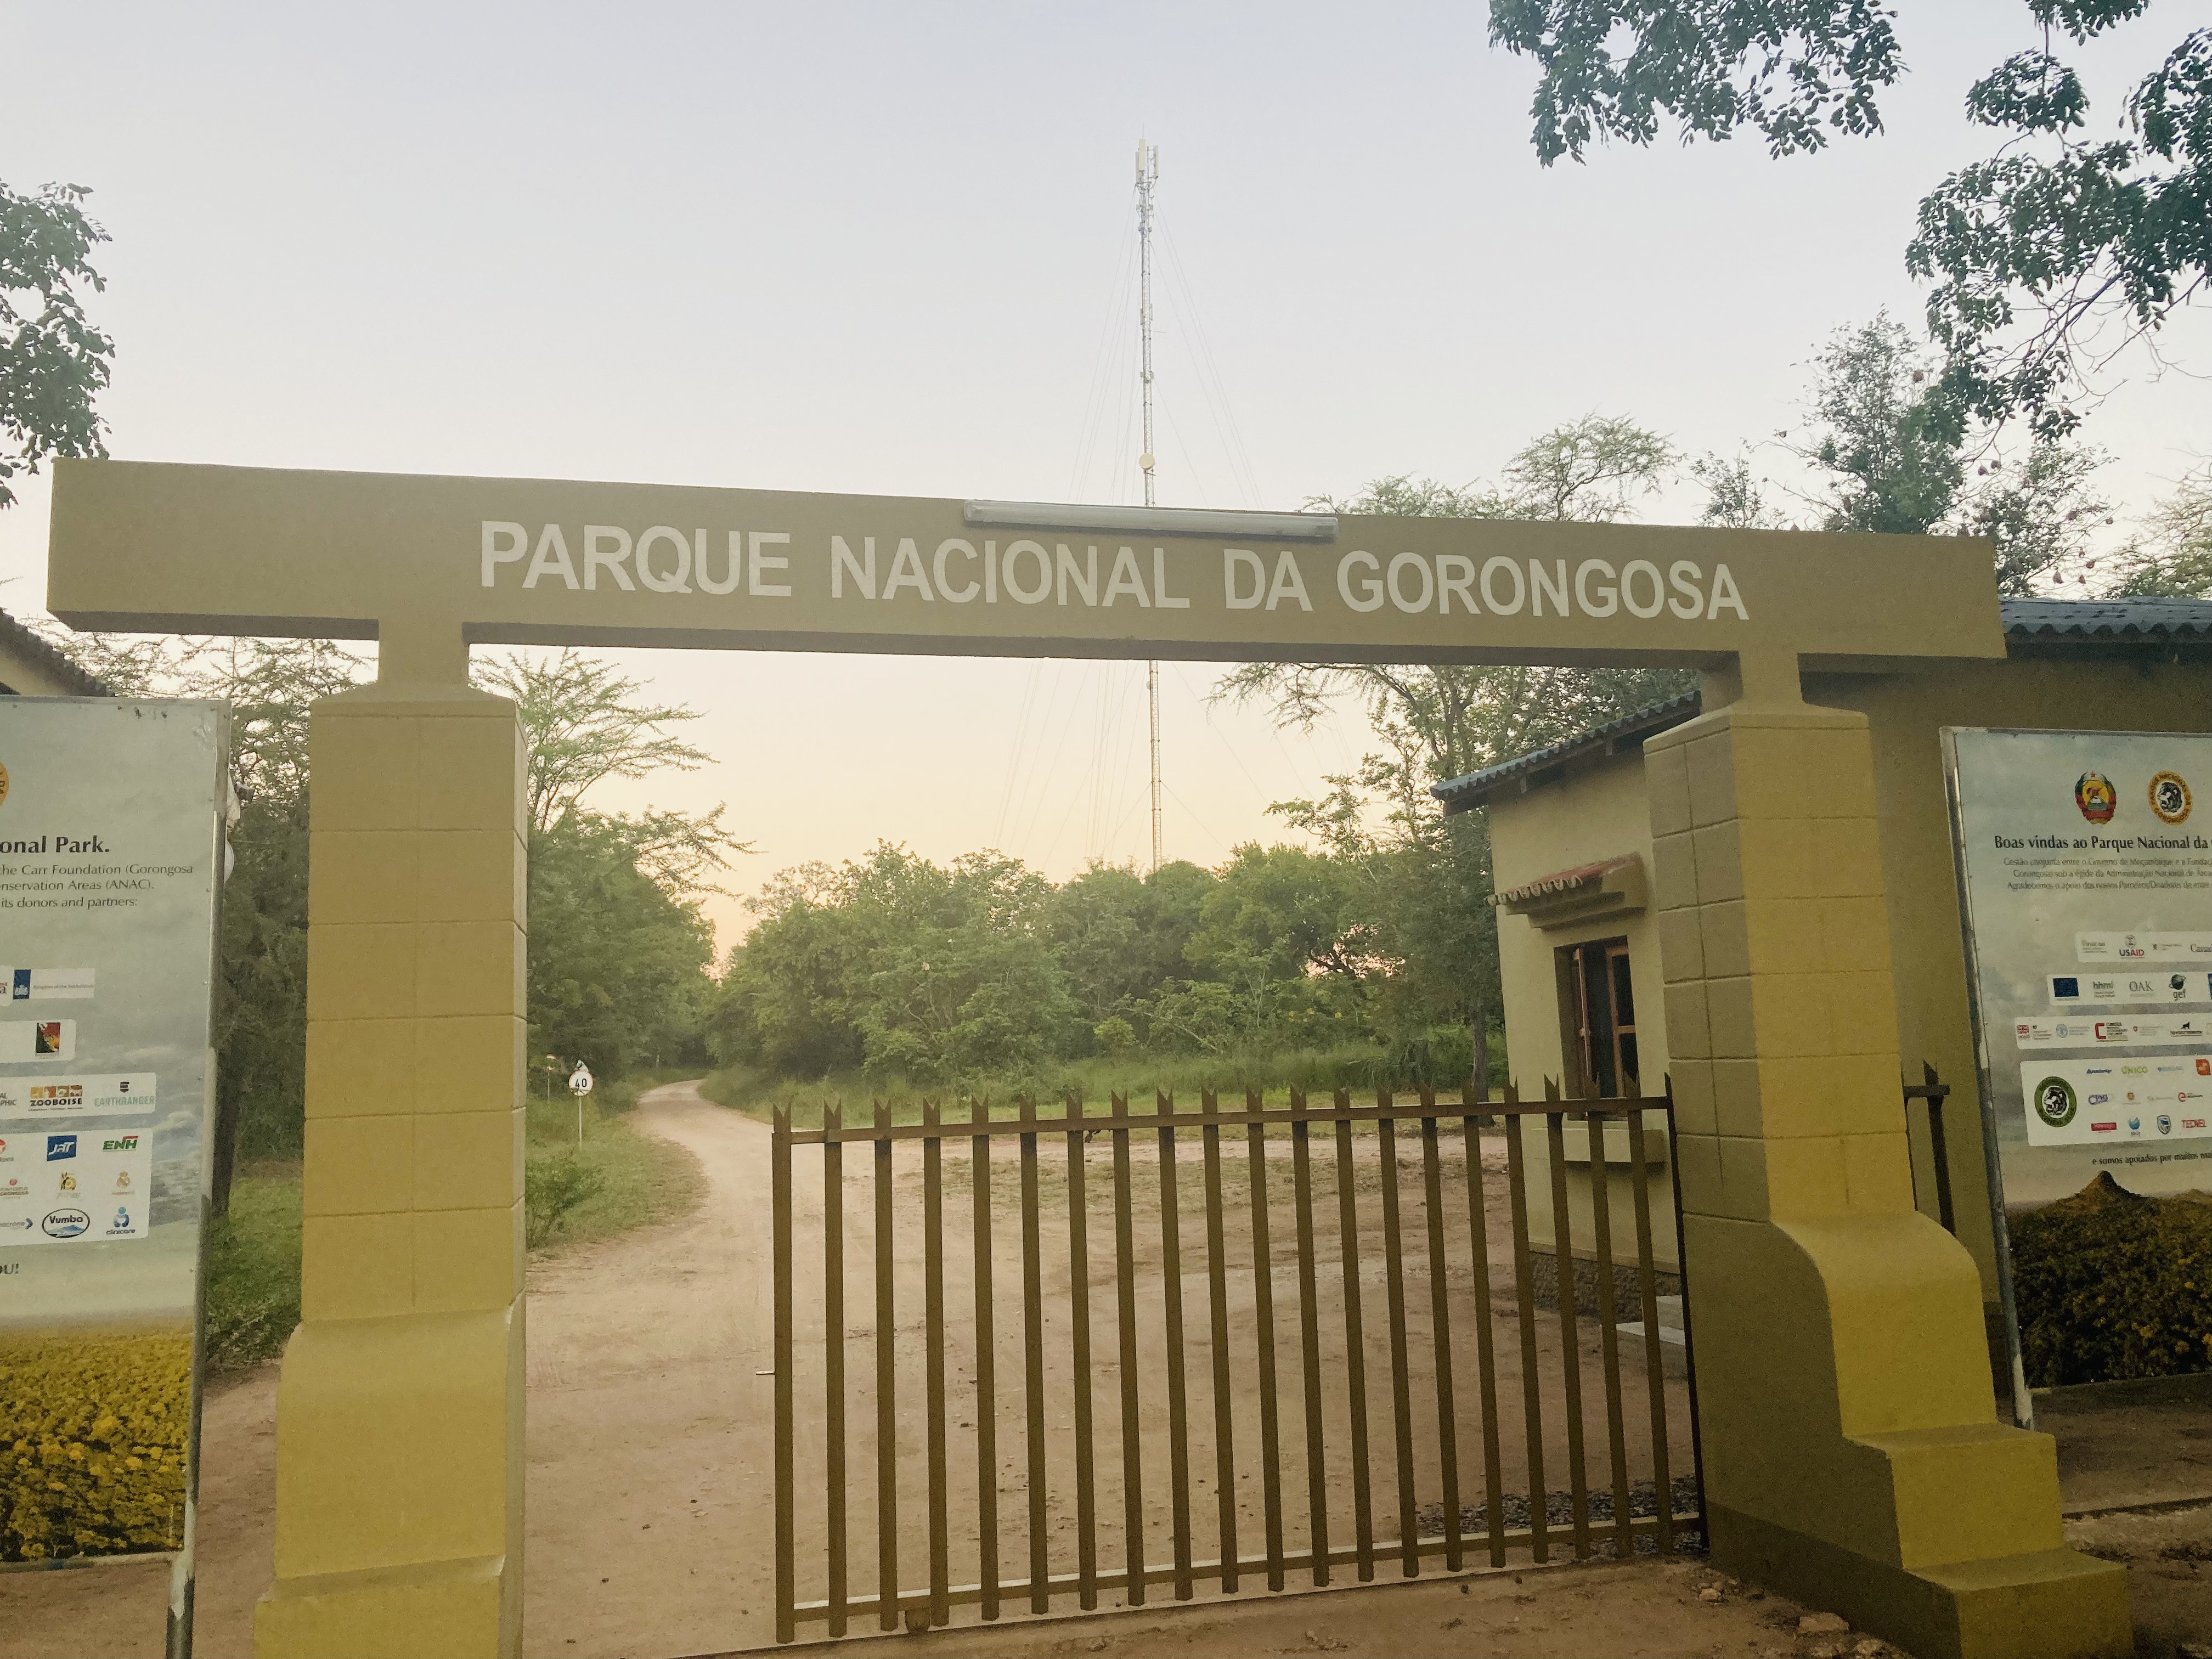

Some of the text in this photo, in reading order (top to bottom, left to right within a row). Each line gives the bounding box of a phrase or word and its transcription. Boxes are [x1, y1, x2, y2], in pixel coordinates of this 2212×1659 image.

[481, 520, 1750, 620] PARQUE NACIONAL DA GORONGOSA
[0, 835, 110, 854] onal Park.
[1994, 834, 2209, 853] Boas vindas ao Parque Nacional da
[21, 864, 48, 875] Carr
[52, 864, 121, 876] Foundation
[126, 864, 193, 877] (Gorongosa
[0, 881, 64, 891] nservation
[67, 880, 102, 890] Areas
[2, 898, 14, 908] its
[17, 896, 58, 908] donors
[61, 896, 84, 907] and
[2129, 980, 2153, 992] OAK
[575, 1078, 587, 1088] 40
[94, 1096, 155, 1107] EARTHRANGER
[102, 1136, 138, 1150] ENH
[49, 1215, 83, 1224] Vumba
[0, 1263, 19, 1274] U!
